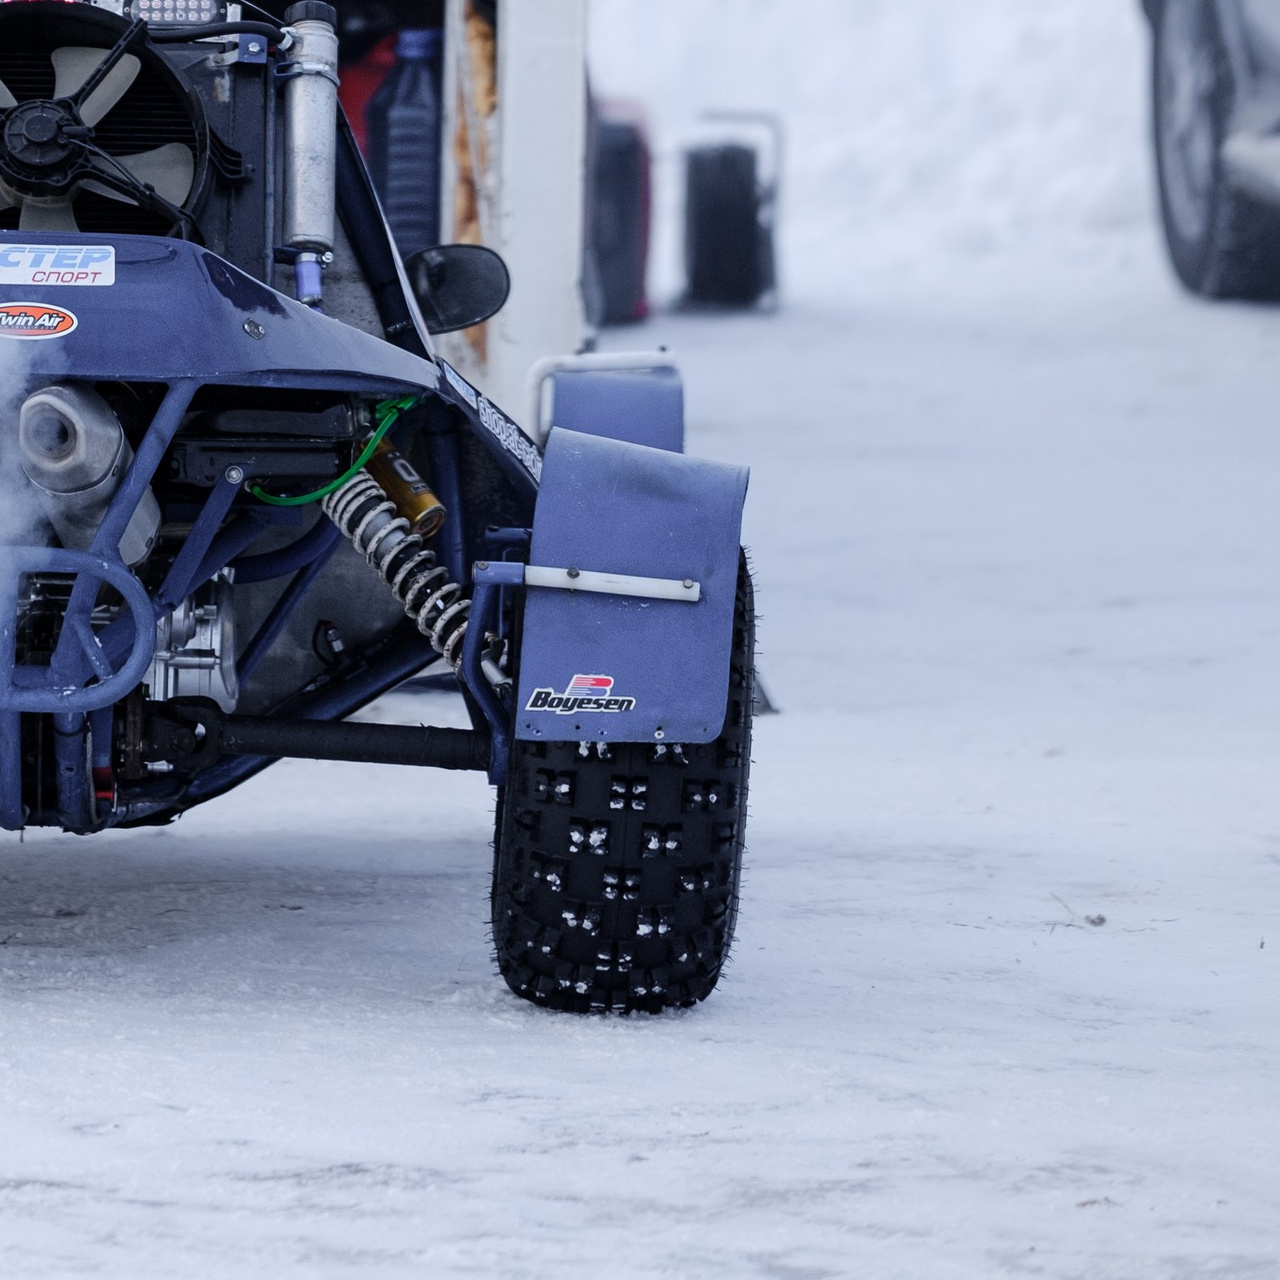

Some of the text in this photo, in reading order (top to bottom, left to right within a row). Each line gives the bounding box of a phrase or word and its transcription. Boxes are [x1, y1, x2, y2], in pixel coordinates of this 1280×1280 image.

[31, 271, 102, 284] СПОРТ
[35, 312, 64, 328] Air
[530, 690, 635, 713] Boyesen
